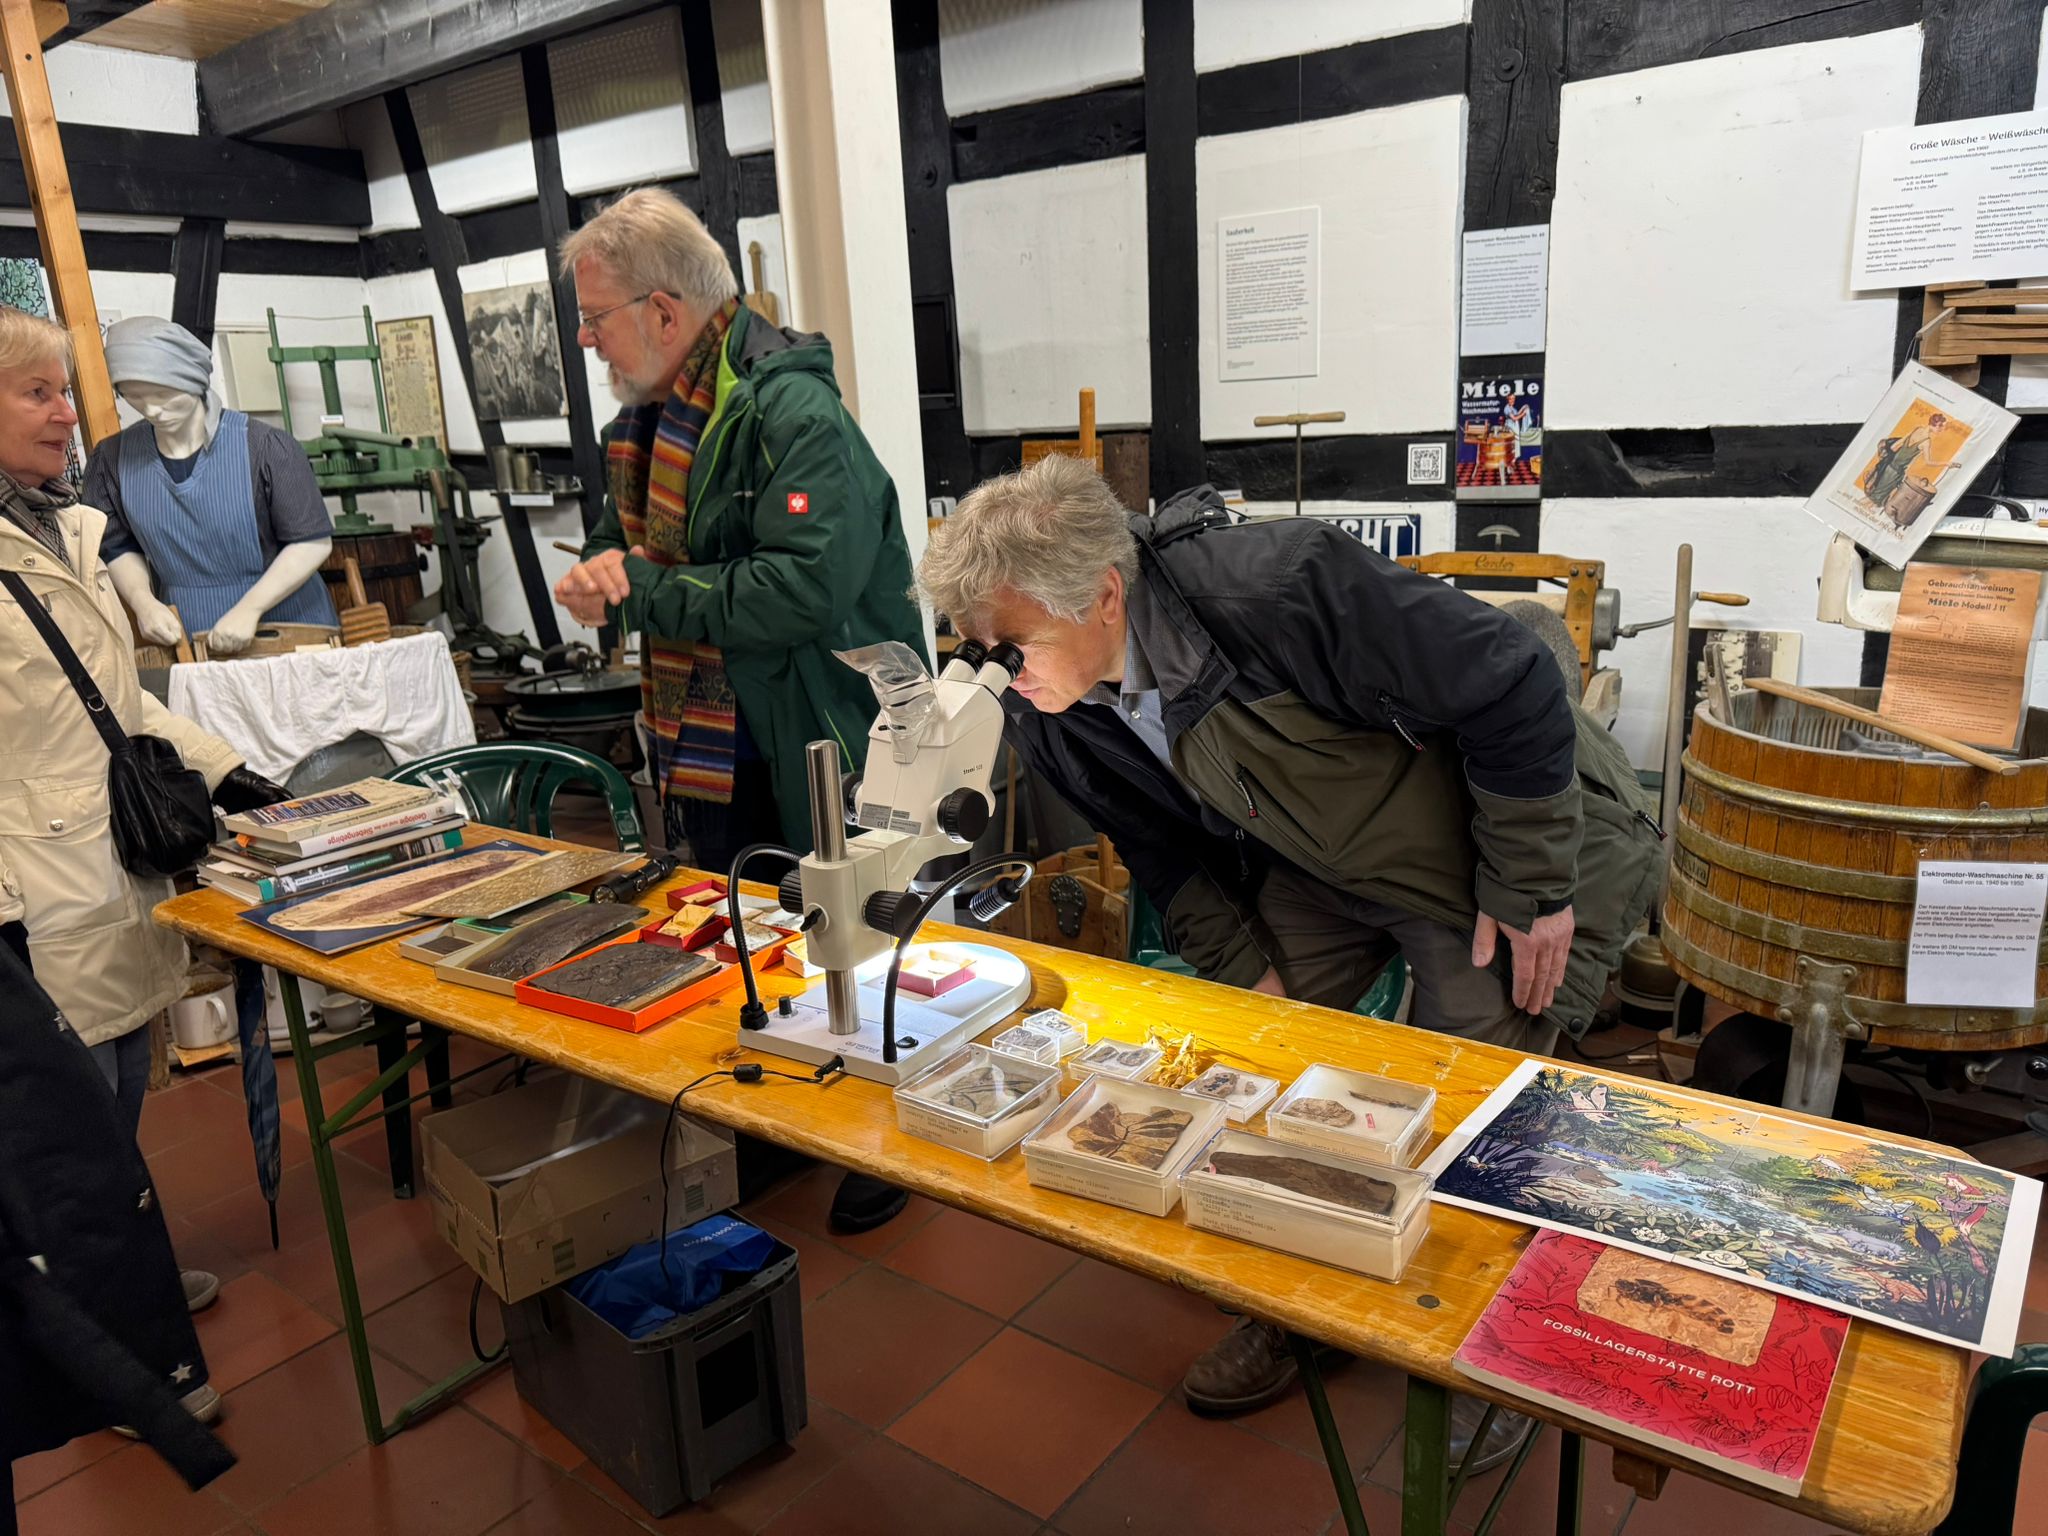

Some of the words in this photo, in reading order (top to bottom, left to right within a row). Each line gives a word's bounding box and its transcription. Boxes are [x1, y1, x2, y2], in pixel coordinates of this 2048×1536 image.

[1910, 141, 1938, 151] Große
[1941, 135, 1978, 146] Wäsche
[1462, 380, 1540, 398] Miele
[1928, 579, 2014, 594] Gebrauchsanweisung
[1928, 598, 1959, 607] Miele
[1962, 601, 1991, 610] Modell
[400, 812, 427, 824] Geologie
[328, 827, 374, 845] Siebengebirge
[1921, 871, 2023, 879] Elektromotor-Waschmaschine
[1543, 1318, 1707, 1380] FOSSILLAGERSTÄTTE
[1710, 1373, 1756, 1394] ROTT
